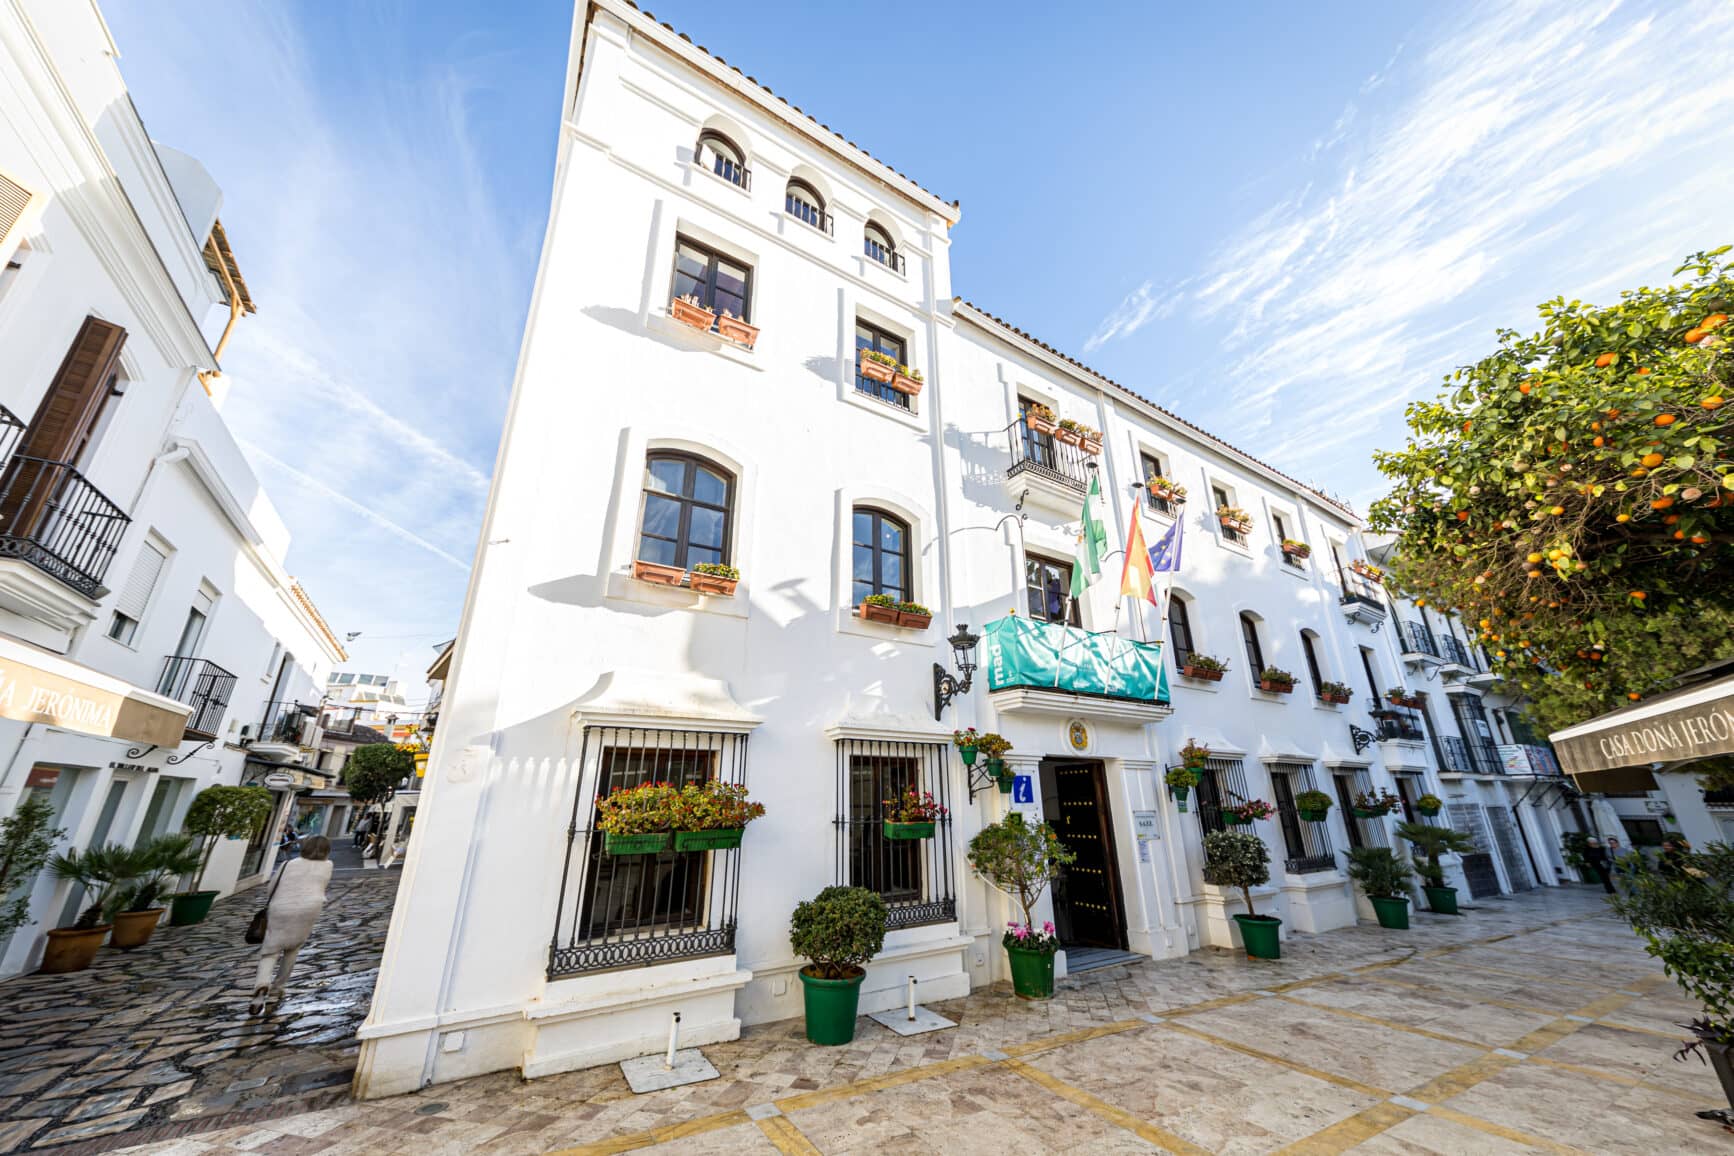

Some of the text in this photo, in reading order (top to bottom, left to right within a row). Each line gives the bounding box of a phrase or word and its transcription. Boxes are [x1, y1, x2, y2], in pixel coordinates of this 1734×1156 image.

[22, 685, 112, 735] JERÓNIMA
[1600, 735, 1634, 759] CASA
[1630, 721, 1684, 753] DOÑA
